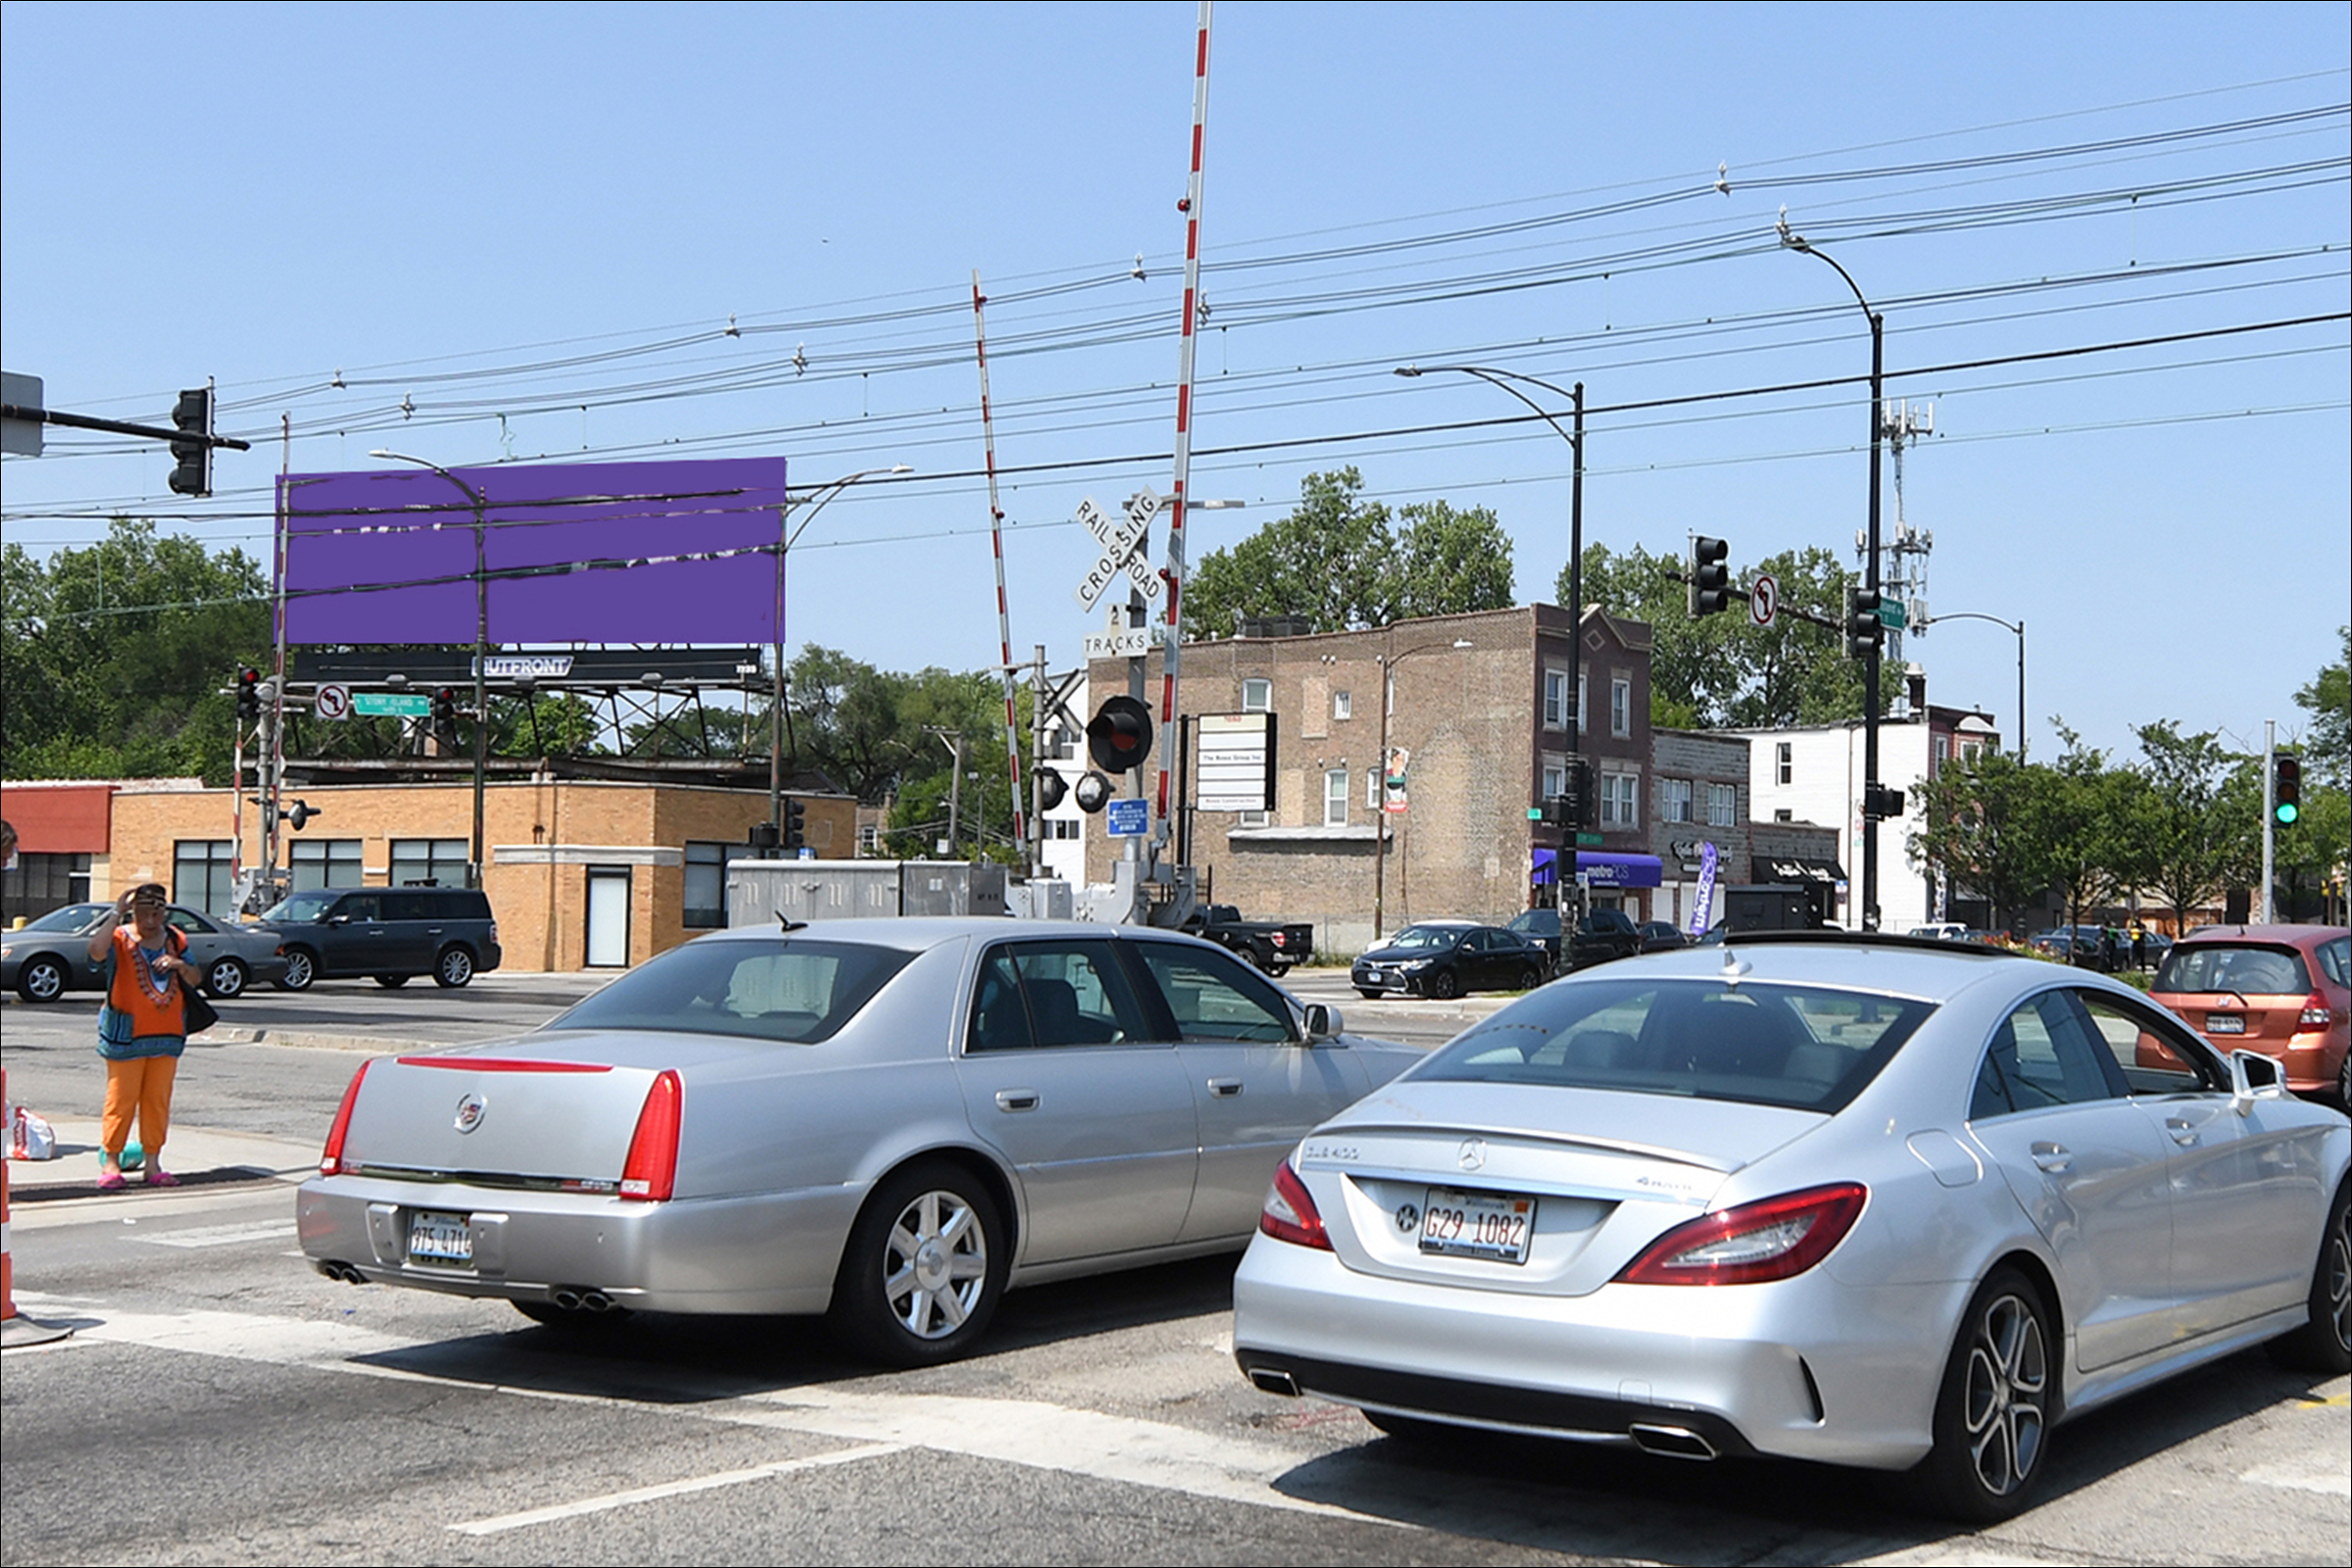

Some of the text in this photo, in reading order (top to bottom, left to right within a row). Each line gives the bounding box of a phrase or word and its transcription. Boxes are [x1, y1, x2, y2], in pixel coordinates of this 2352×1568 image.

[1077, 500, 1160, 599] RAIL ROAD
[1079, 495, 1155, 603] CROSSING
[1110, 605, 1120, 625] 2
[1084, 634, 1146, 653] TRACKS
[484, 658, 568, 674] UTFRONT
[413, 1226, 436, 1252] 975
[1425, 1206, 1525, 1248] G29 1082
